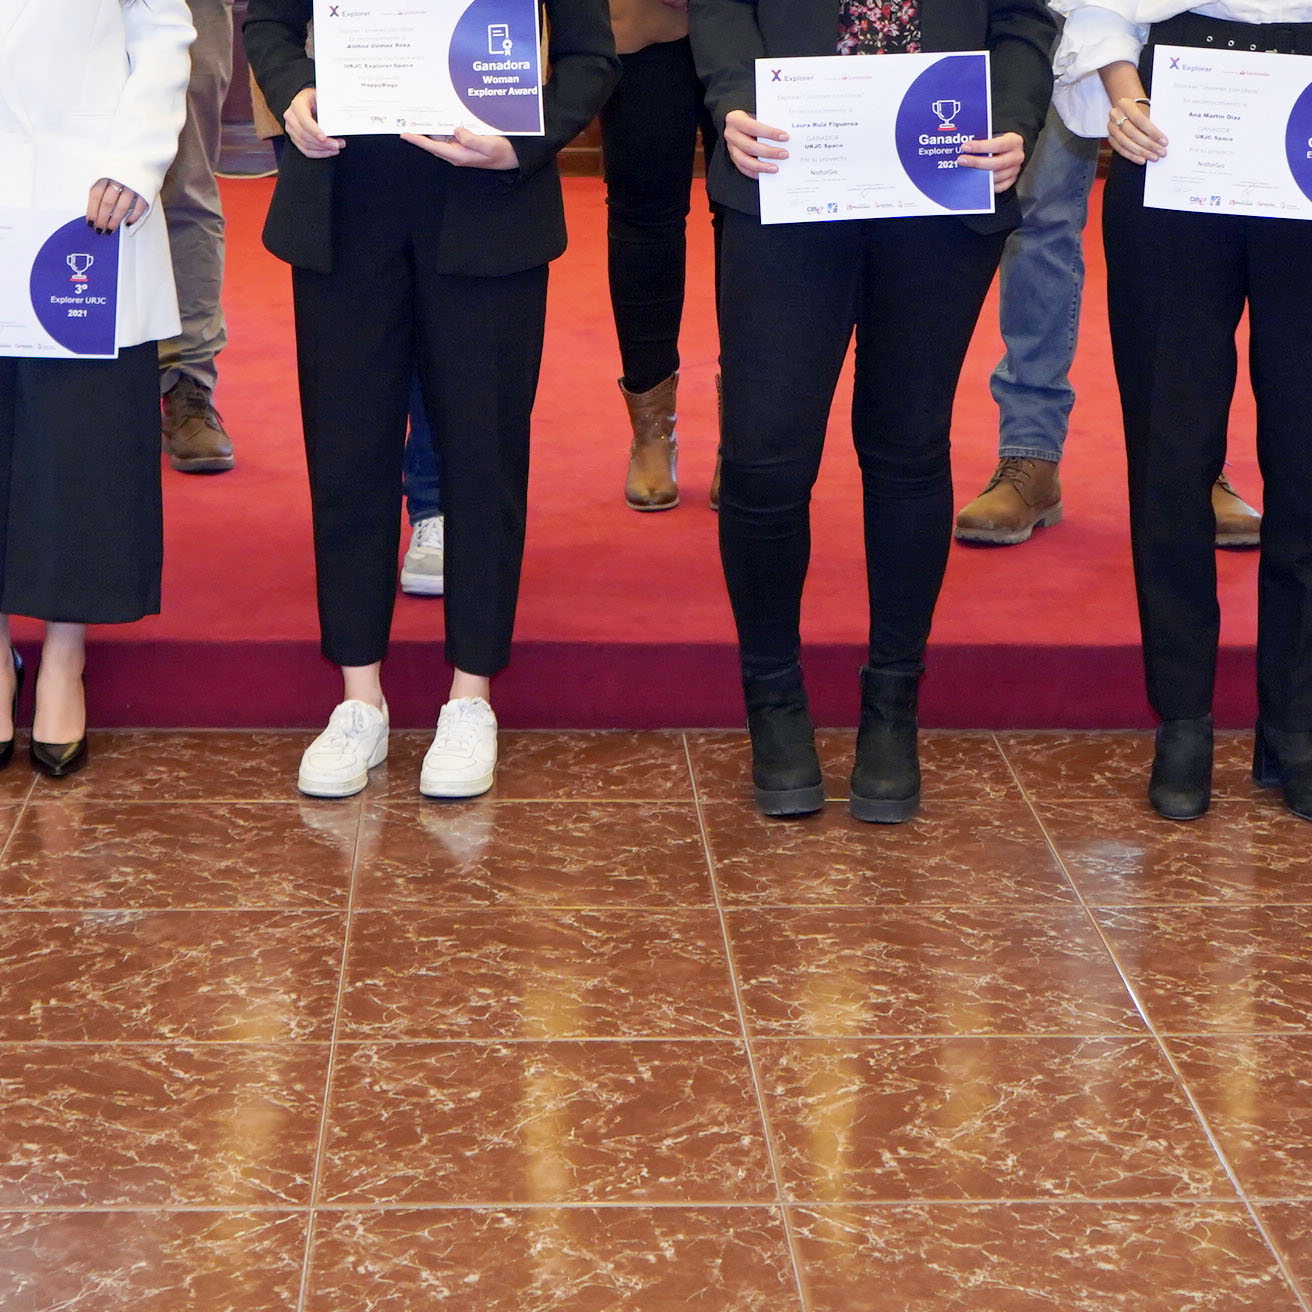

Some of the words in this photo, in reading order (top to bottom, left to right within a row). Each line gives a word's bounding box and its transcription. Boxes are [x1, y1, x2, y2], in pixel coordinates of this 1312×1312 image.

[342, 10, 371, 18] Explorer
[473, 60, 530, 71] Ganadora
[1182, 64, 1212, 73] Explorer
[482, 75, 519, 83] Woman
[468, 88, 506, 97] Explorer
[508, 87, 537, 96] Award
[919, 133, 975, 145] Ganador
[919, 147, 955, 156] Explorer
[938, 160, 958, 168] 2021
[74, 284, 88, 294] 3º
[50, 296, 84, 305] Explorer
[85, 296, 106, 304] URJC
[67, 309, 88, 317] 2021
